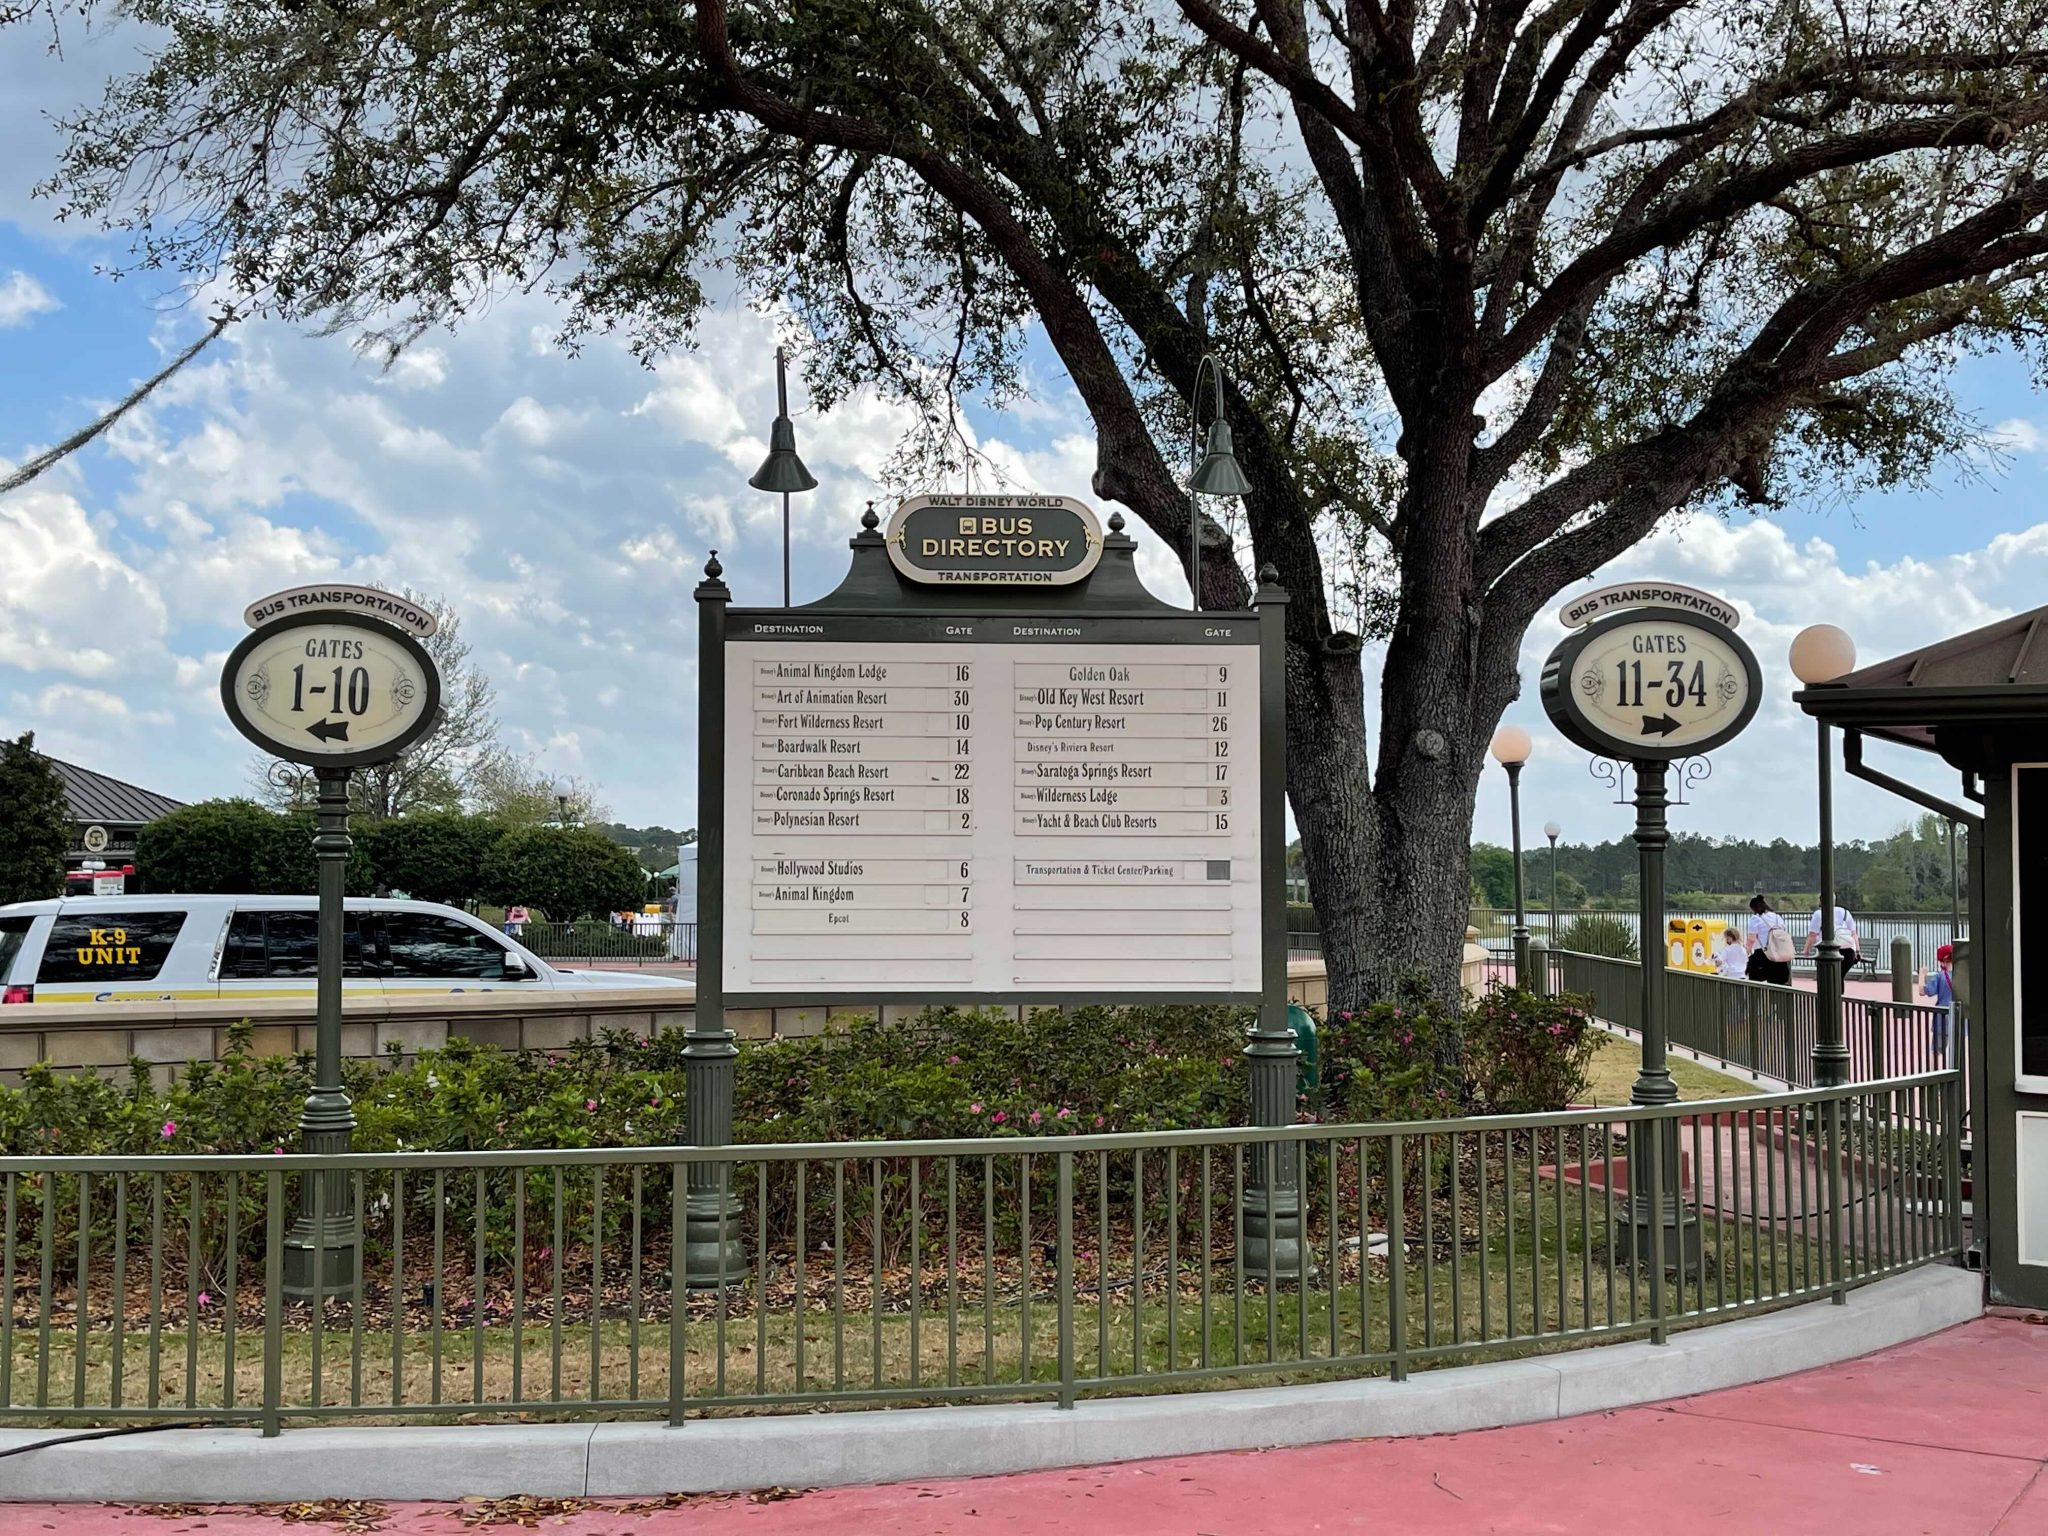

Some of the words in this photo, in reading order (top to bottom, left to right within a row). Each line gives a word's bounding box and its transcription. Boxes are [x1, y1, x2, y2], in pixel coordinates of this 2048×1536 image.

[929, 497, 963, 506] WALT
[966, 498, 1012, 507] DISNEY
[1017, 499, 1063, 507] WORLD
[982, 518, 1033, 534] BUS
[922, 539, 1070, 557] DIRECTORY
[938, 572, 1052, 582] TRANSPORTATION
[253, 601, 285, 621] BUS
[288, 592, 429, 630] TRANSPORTATION
[1569, 601, 1598, 621] BUS
[1601, 590, 1732, 624] TRANSPORTATION
[754, 625, 823, 633] DESTINATION
[946, 626, 972, 635] GATE
[1013, 627, 1081, 636] DESTINATION
[1205, 628, 1231, 637] GATE
[306, 639, 363, 659] GATES
[1633, 635, 1686, 654] GATES
[777, 664, 810, 678] Animal
[814, 664, 855, 680] Kingdom
[859, 664, 887, 681] Lodge
[956, 665, 969, 681] 16
[1070, 667, 1105, 681] Golden
[1109, 667, 1130, 681] Oak
[1220, 667, 1227, 682] 9
[291, 664, 369, 716] 1-10
[1616, 660, 1707, 708] 11-34
[777, 690, 792, 704] Art
[795, 690, 803, 704] of
[806, 690, 854, 704] Animation
[857, 691, 887, 704] Resort
[954, 690, 969, 705] 30
[1038, 689, 1055, 705] Old
[1060, 689, 1077, 707] Key
[1081, 689, 1105, 705] West
[1109, 690, 1144, 705] Resort
[1217, 692, 1226, 707] 11
[778, 715, 797, 728] Fort
[801, 715, 850, 728] Wilderness
[853, 715, 883, 728] Resort
[956, 715, 969, 730] 10
[1035, 715, 1052, 731] Pop
[1055, 715, 1092, 731] Century
[1095, 716, 1125, 729] Resort
[1212, 716, 1227, 731] 26
[778, 739, 827, 753] Boardwalk
[830, 739, 861, 753] Resort
[956, 739, 969, 754] 14
[1027, 742, 1058, 754] Disney's
[1061, 743, 1087, 752] Riviera
[1090, 743, 1114, 752] Resort
[1215, 741, 1228, 757] 12
[778, 764, 824, 778] Caribbean
[827, 765, 855, 778] Beach
[859, 765, 888, 778] Resort
[955, 764, 969, 779] 22
[1037, 764, 1079, 780] Saratoga
[1082, 764, 1118, 780] Springs
[1122, 765, 1152, 778] Resort
[1216, 765, 1227, 780] 17
[777, 787, 821, 801] Coronado
[824, 787, 860, 803] Springs
[864, 788, 894, 801] Resort
[956, 788, 969, 804] 18
[1037, 788, 1086, 802] Wilderness
[1090, 789, 1117, 805] Lodge
[1221, 790, 1227, 805] 3
[774, 812, 824, 828] Polynesian
[828, 812, 859, 826] Resort
[962, 813, 970, 828] 2
[1037, 815, 1061, 828] Yacht
[1064, 815, 1070, 828] &
[1074, 815, 1099, 828] Beach
[1102, 815, 1121, 828] Club
[1124, 815, 1156, 828] Resorts
[1216, 814, 1227, 830] 15
[777, 861, 824, 878] Hollywood
[828, 861, 863, 875] Studios
[961, 862, 968, 878] 6
[1026, 865, 1081, 876] Transportation
[1084, 865, 1089, 875] &
[1092, 865, 1115, 875] Ticket
[1117, 865, 1173, 877] Center/Parking
[775, 887, 809, 900] Animal
[812, 887, 854, 903] Kingdom
[962, 887, 969, 902] 7
[829, 913, 849, 925] Epcot
[961, 912, 968, 927] 8
[89, 929, 127, 945] K-9
[76, 948, 141, 965] UNIT
